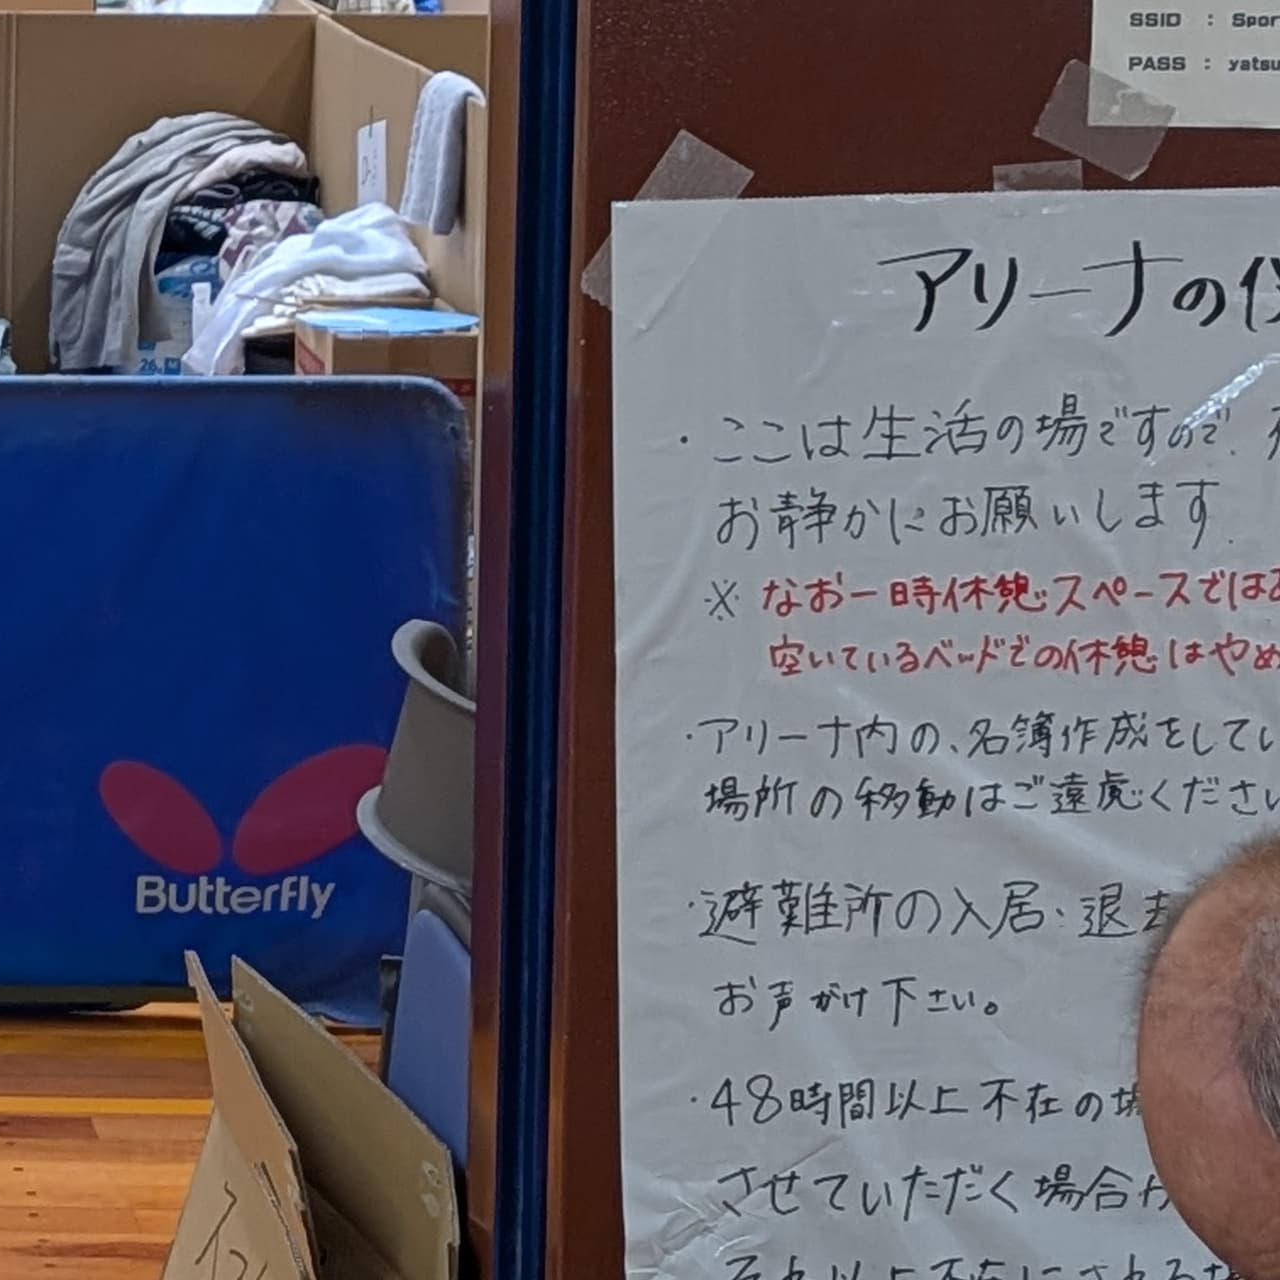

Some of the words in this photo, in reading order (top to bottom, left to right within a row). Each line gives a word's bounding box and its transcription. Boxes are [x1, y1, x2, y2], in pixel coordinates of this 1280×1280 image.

[1129, 12, 1182, 28] SSID
[1128, 56, 1187, 71] PASS
[136, 874, 336, 919] Butterfly
